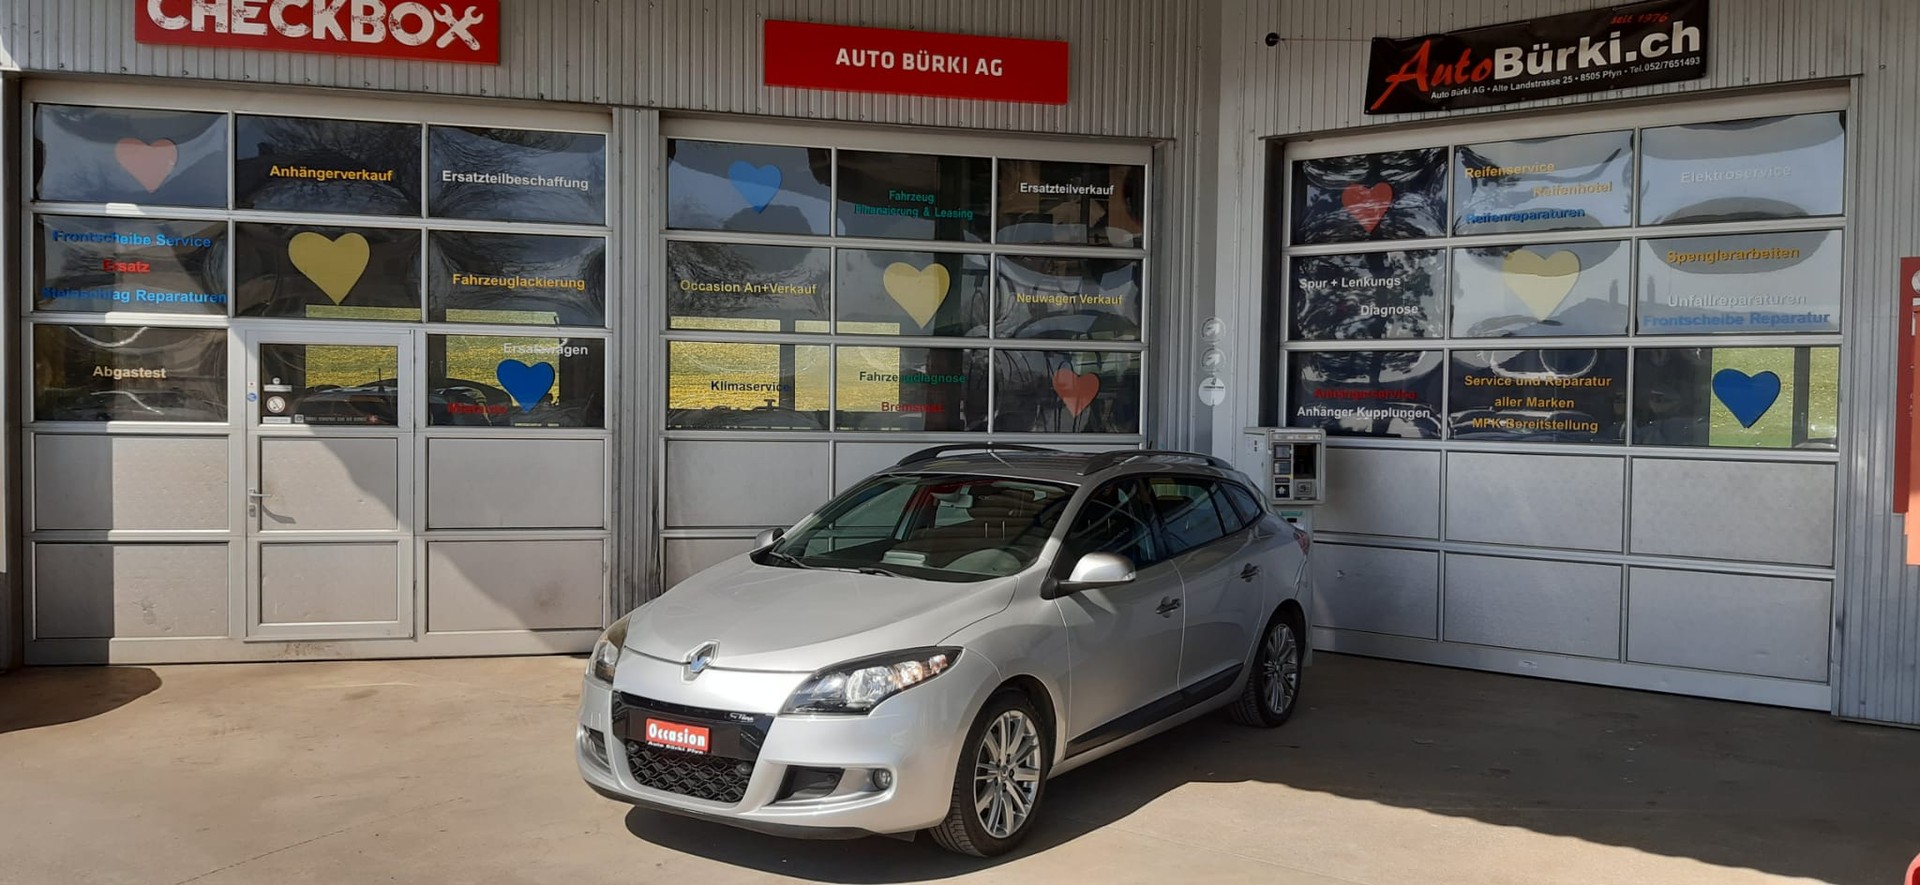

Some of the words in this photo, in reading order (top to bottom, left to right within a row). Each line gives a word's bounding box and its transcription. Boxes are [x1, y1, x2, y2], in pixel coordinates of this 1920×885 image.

[836, 48, 895, 69] AUTO
[903, 50, 967, 74] BÜRKI
[975, 58, 1003, 77] AG
[1431, 91, 1449, 99] Auto
[1451, 89, 1470, 97] Bürki
[1472, 86, 1485, 94] AG
[1510, 79, 1561, 91] Landstrasse
[1563, 75, 1573, 84] 25
[1580, 71, 1601, 82] 8505
[1602, 69, 1622, 80] Pfyn
[270, 164, 393, 184] Anhängerverkauf
[1465, 162, 1556, 178] Reifenservice
[1680, 165, 1792, 183] Elektroservice
[442, 170, 589, 191] Ersatzteilbeschaffung
[1020, 182, 1114, 195] Ersatzteilverkauf
[1532, 181, 1613, 197] Reifenhotel
[889, 190, 934, 204] Fahrzeug
[923, 207, 930, 217] &
[935, 207, 974, 220] Leasing
[1466, 208, 1586, 224] Reifenreparaturen
[52, 230, 151, 246] Frontscheibe
[156, 233, 212, 248] Service
[1667, 247, 1800, 265] Spenglerarbeiten
[102, 259, 150, 273] Ersatz
[452, 273, 586, 291] Fahrzeuglackierung
[680, 279, 741, 293] Occasion
[743, 282, 817, 295] An+Verkauf
[1299, 278, 1328, 290] Spur
[1341, 276, 1401, 290] Lenkungs
[136, 289, 227, 304] Reparaturen
[1016, 293, 1076, 305] Neuwagen
[1079, 294, 1123, 305] Verkauf
[1668, 293, 1807, 308] Unfallreparaturen
[1360, 304, 1419, 317] Diagnose
[1643, 313, 1744, 327] Frontscheibe
[1750, 312, 1831, 327] Reparatur
[504, 342, 588, 358] Ersatzwagen
[93, 365, 166, 383] Abgastest
[1464, 375, 1514, 386] Service
[1515, 376, 1541, 386] und
[1545, 376, 1612, 388] Reparatur
[711, 380, 791, 392] Klimaservice
[1494, 396, 1523, 407] aller
[1526, 396, 1575, 408] Marken
[1297, 406, 1354, 418] Anhänger
[1356, 406, 1431, 420] Kupplungen
[1505, 418, 1599, 433] Bereitstellung
[648, 723, 706, 747] Occasion
